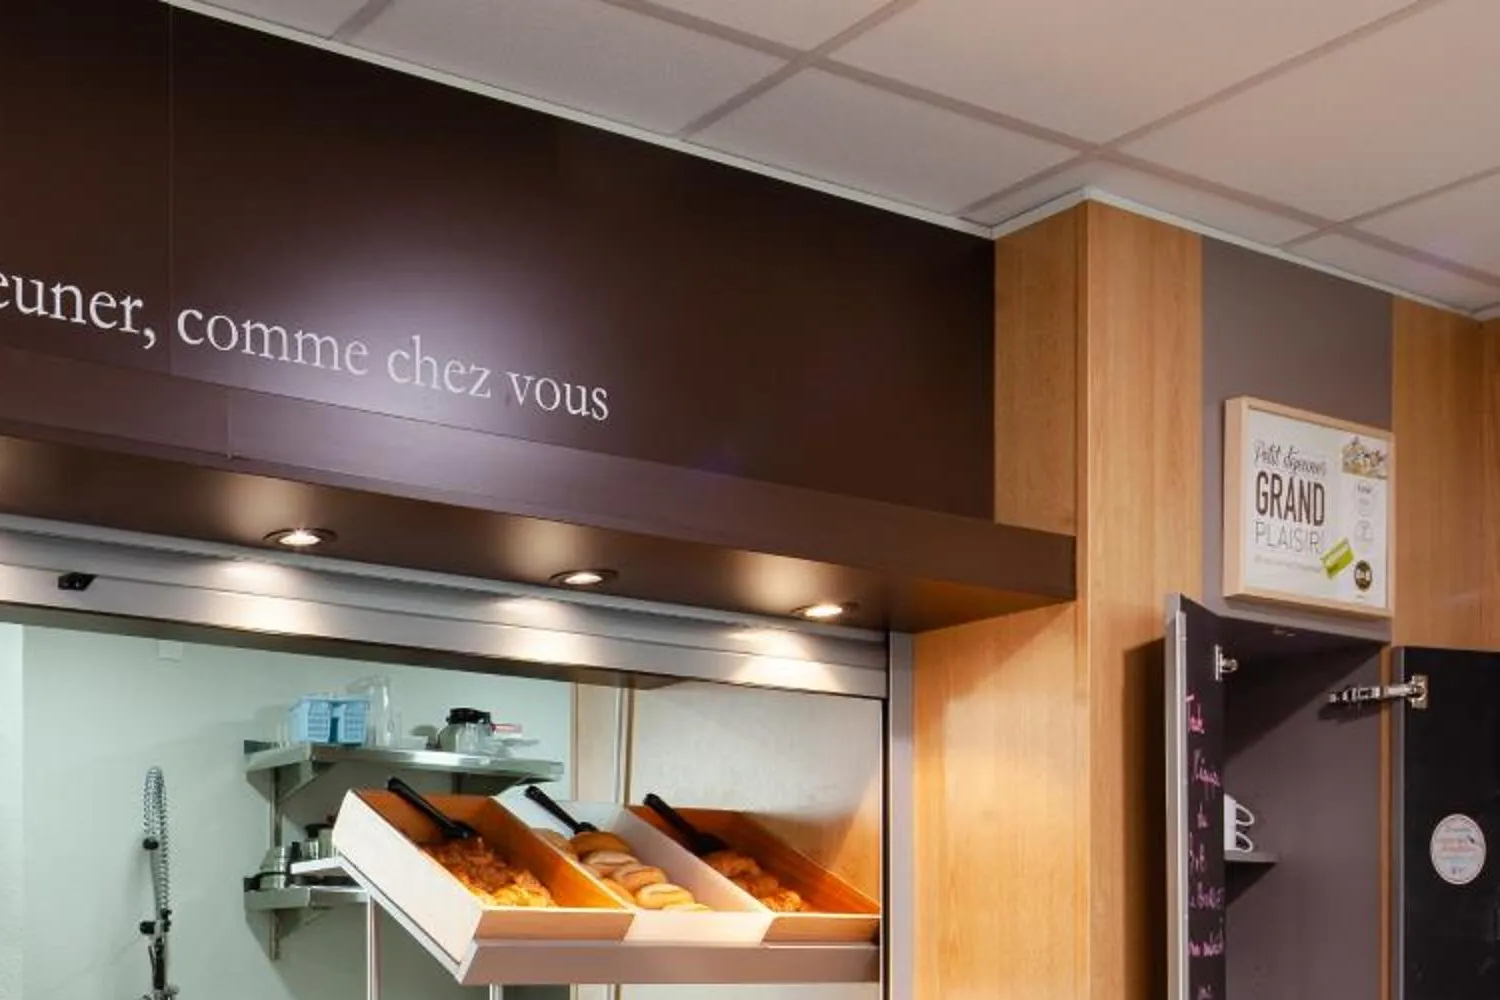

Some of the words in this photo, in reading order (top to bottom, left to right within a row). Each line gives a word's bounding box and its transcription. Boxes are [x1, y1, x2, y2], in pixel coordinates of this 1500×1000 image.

[176, 305, 370, 376] comme
[386, 335, 493, 399] chez
[504, 370, 611, 421] vous
[1255, 470, 1326, 527] GRAND
